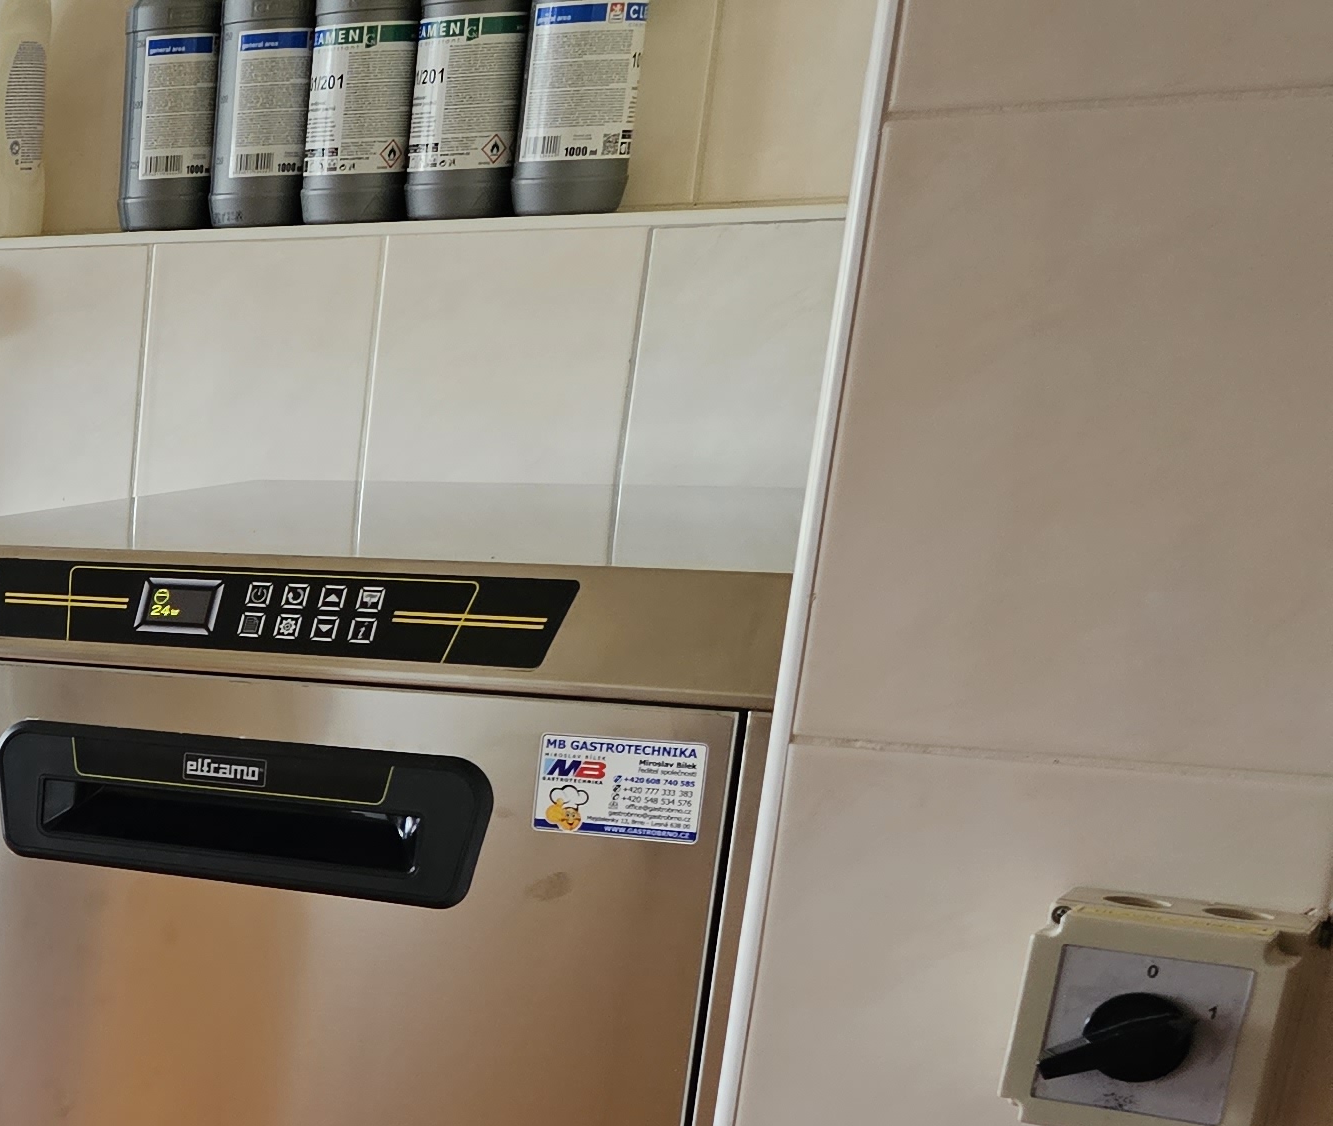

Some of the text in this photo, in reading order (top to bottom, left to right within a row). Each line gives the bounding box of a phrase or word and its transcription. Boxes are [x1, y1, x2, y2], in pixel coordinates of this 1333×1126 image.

[564, 146, 588, 157] 1000
[186, 165, 204, 174] 1000
[277, 163, 296, 173] 1000
[546, 738, 698, 759] MB GASTROTECHNIKA
[186, 758, 260, 781] elframo
[546, 758, 607, 779] MB
[638, 759, 675, 768] Miroslav
[624, 776, 645, 784] +420
[645, 777, 661, 785] 608
[680, 780, 696, 788] 585
[623, 786, 643, 794] +420
[645, 787, 660, 795] 777
[661, 788, 676, 797] 333
[621, 795, 642, 804] +420
[677, 799, 693, 807] 576
[1146, 964, 1159, 979] 0
[1208, 1005, 1218, 1020] 1
